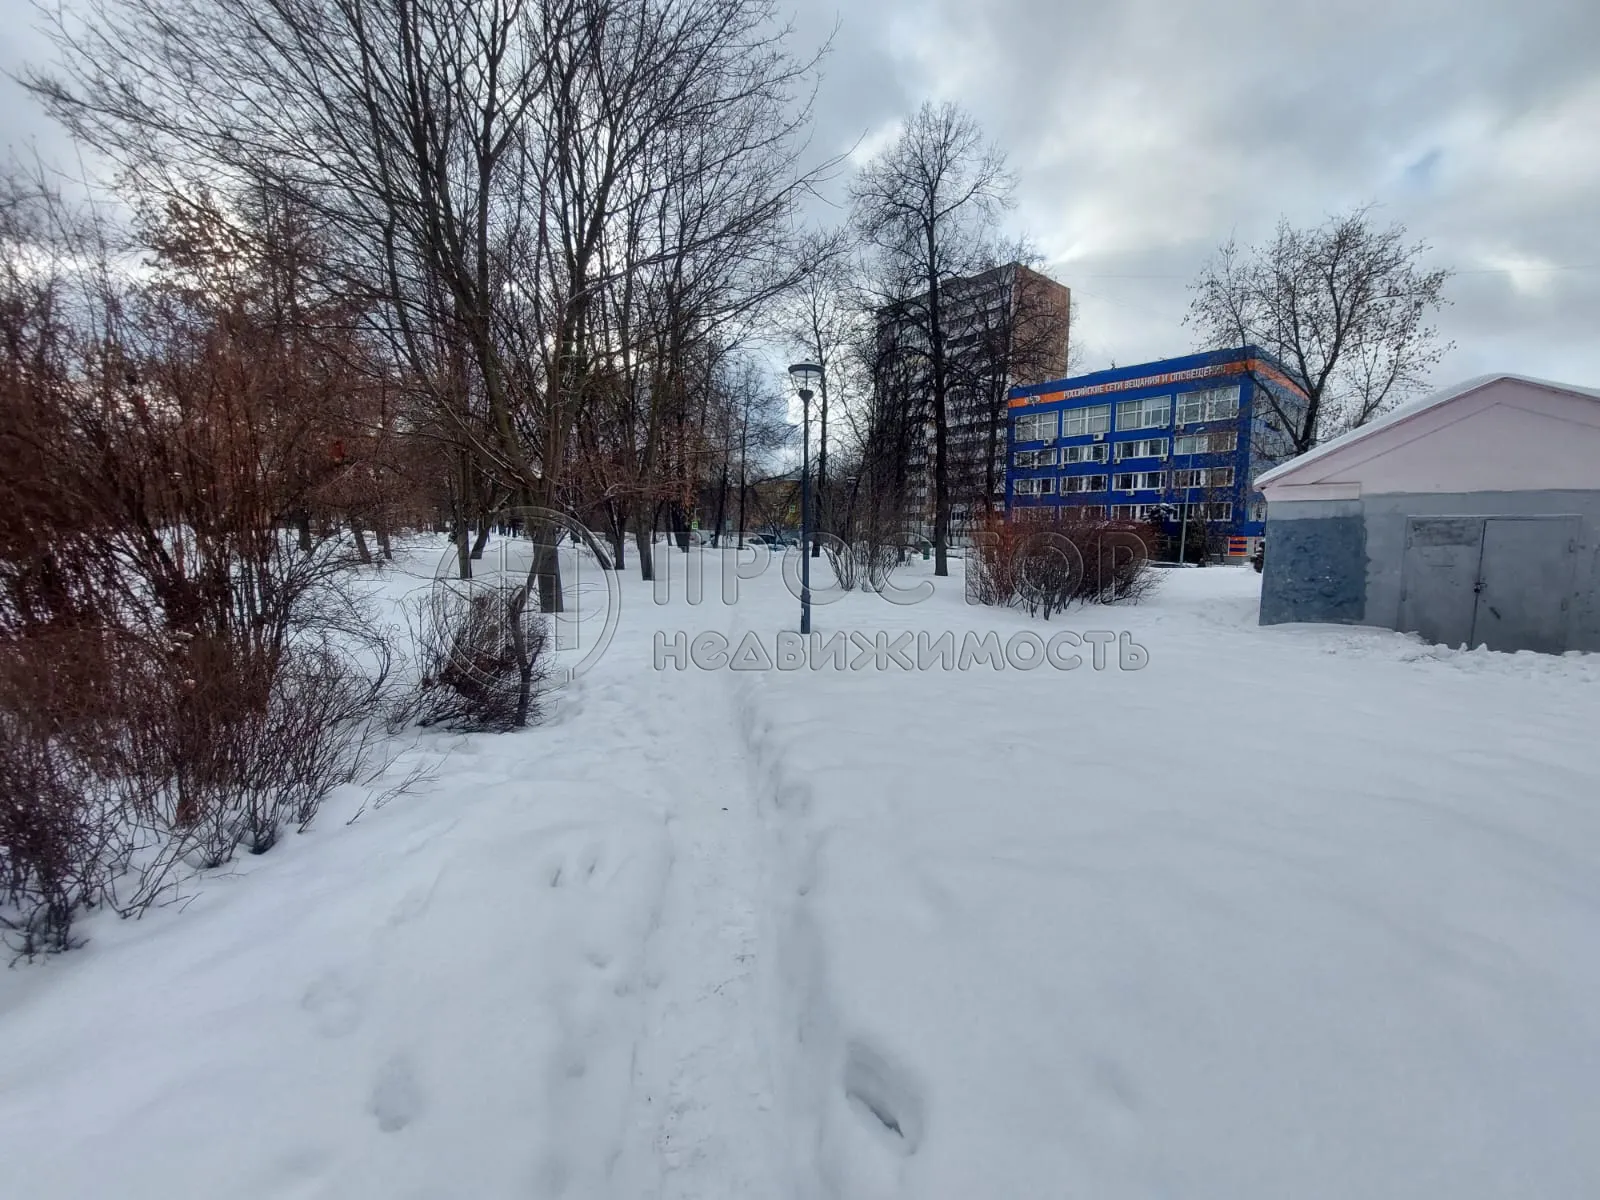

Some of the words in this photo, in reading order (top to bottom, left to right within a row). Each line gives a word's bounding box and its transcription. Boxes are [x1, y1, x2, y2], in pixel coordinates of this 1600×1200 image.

[1105, 380, 1123, 393] СЕТИ
[1124, 374, 1160, 390] ВЕЩАНИЯ
[1161, 373, 1169, 384] И
